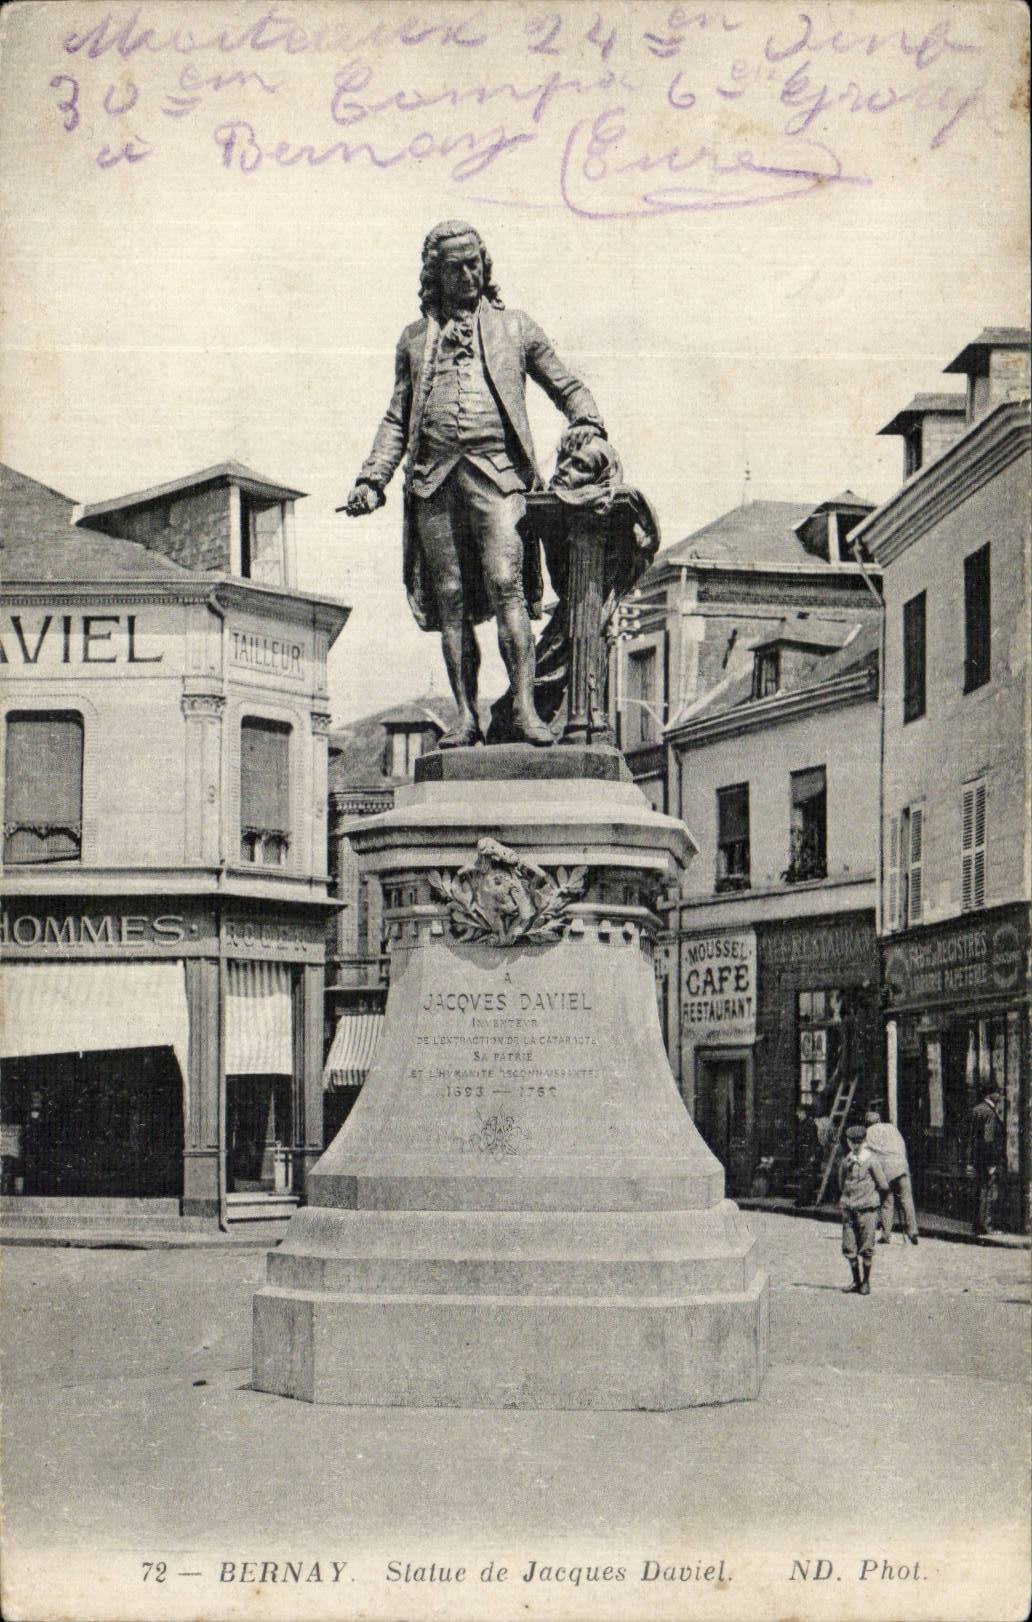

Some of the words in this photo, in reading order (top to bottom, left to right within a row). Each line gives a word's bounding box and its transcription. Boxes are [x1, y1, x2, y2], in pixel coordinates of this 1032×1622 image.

[233, 632, 302, 673] TAILLEUR
[520, 992, 592, 1011] DAVIEL
[683, 997, 752, 1022] RESTAURANT
[416, 1036, 429, 1045] DE
[507, 1036, 519, 1045] DE
[524, 1036, 536, 1045] LA
[539, 1036, 597, 1045] CATARACTE
[494, 1053, 533, 1062] PATRIE
[410, 1070, 424, 1079] ET
